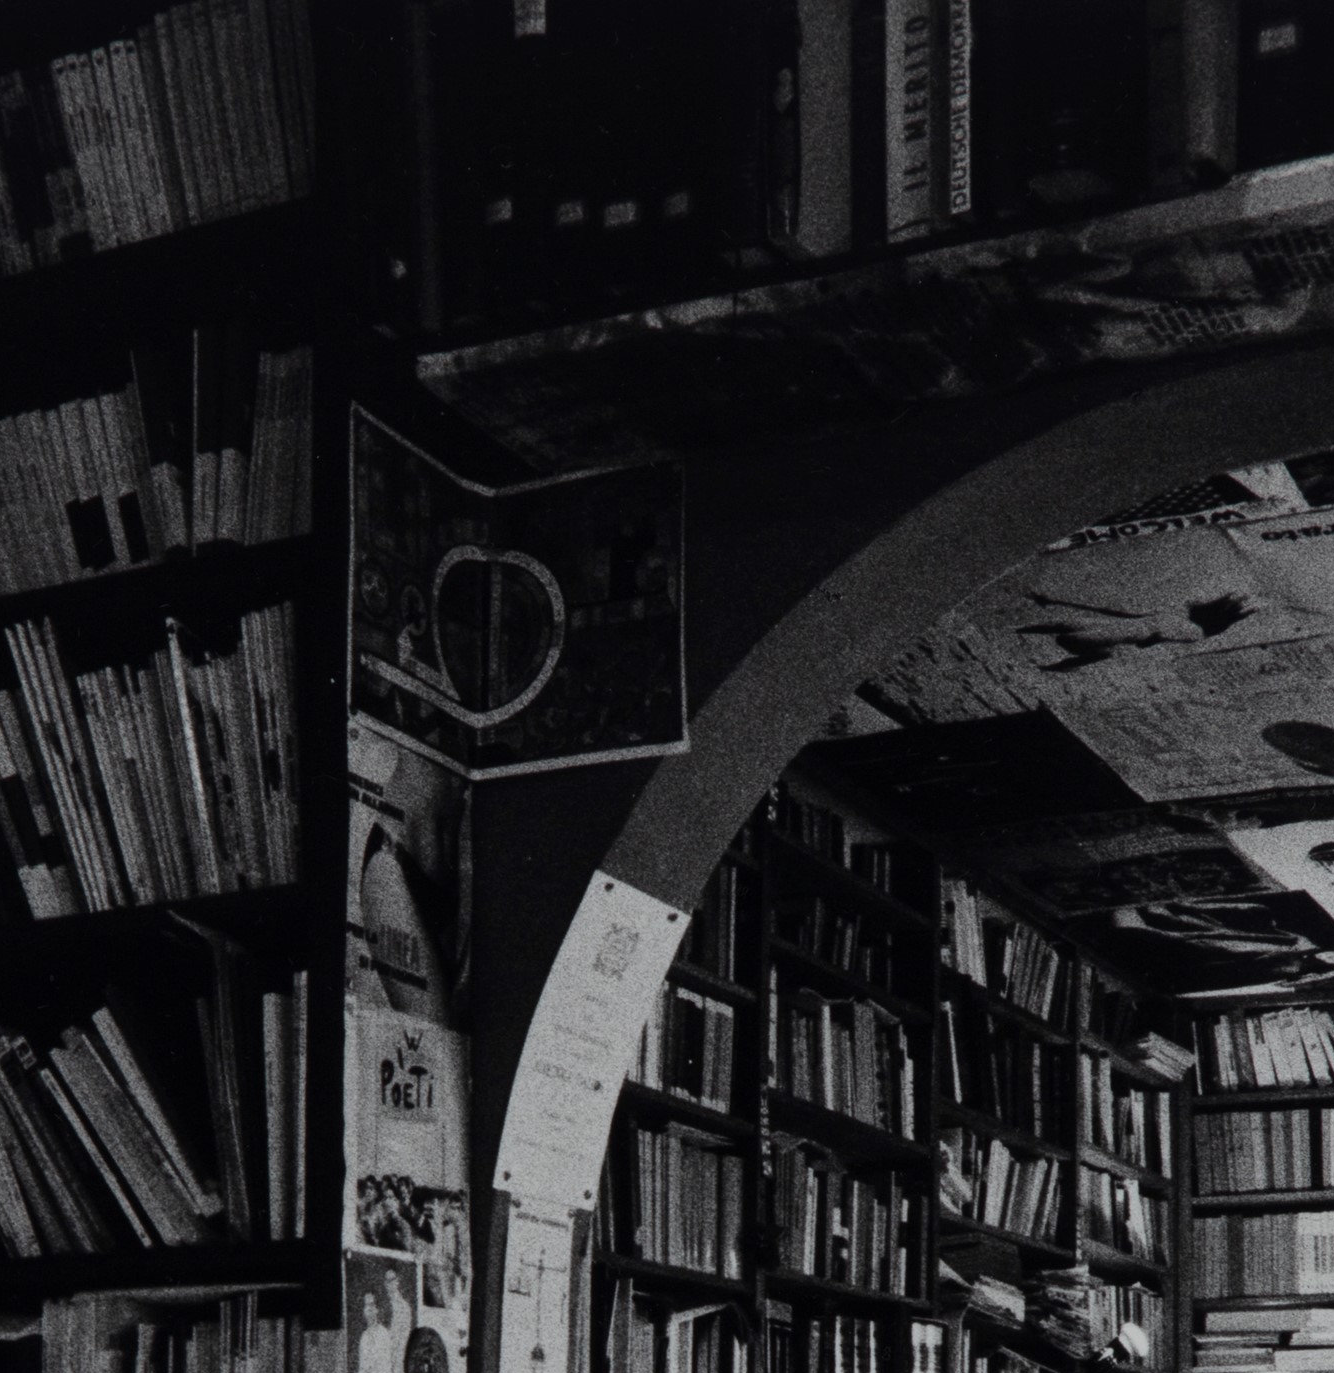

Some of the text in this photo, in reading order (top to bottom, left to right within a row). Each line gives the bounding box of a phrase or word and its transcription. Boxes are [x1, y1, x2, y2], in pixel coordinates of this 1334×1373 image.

[903, 14, 929, 191] IL MERITO
[951, 0, 969, 207] DEUTSCHE DEMOKR
[1068, 509, 1247, 548] WELCOME
